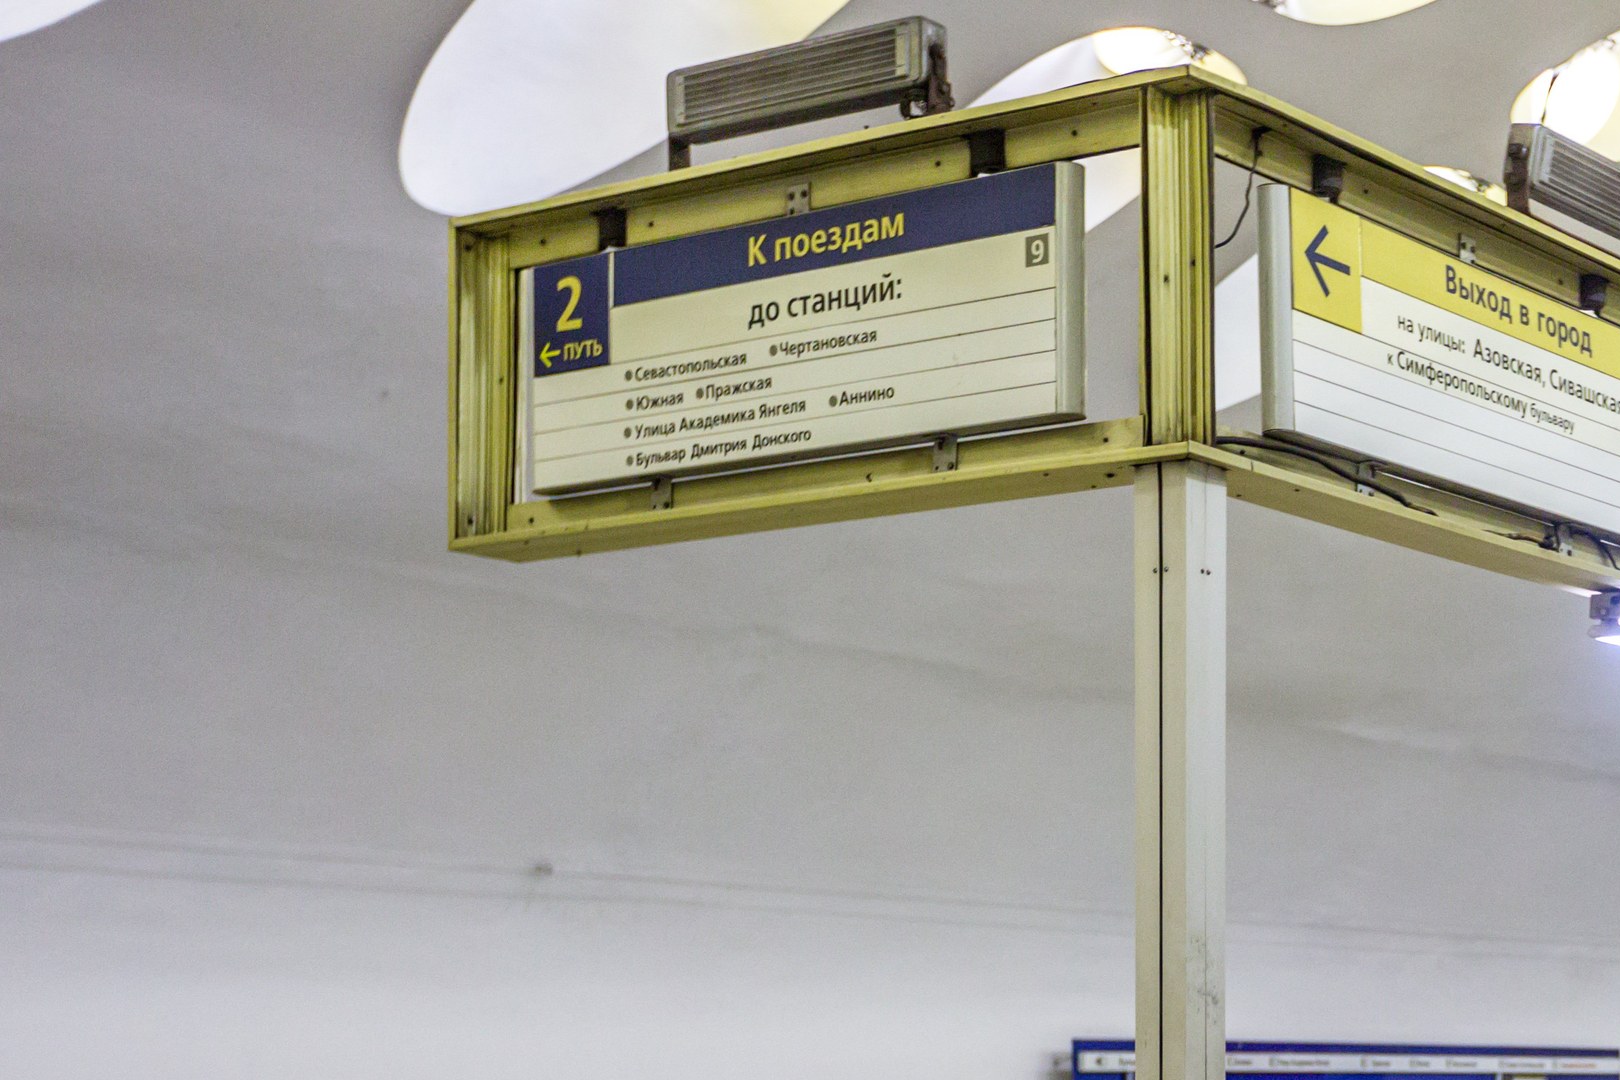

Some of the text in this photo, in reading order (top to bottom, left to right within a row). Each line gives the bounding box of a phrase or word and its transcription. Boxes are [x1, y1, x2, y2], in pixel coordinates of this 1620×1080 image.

[747, 211, 905, 267] К поездам
[1030, 239, 1047, 263] 9
[555, 275, 584, 334] 2
[747, 273, 903, 330] до станций:
[1445, 264, 1593, 358] Выход в город
[634, 327, 878, 381] Севастопольская Чертановская
[1397, 313, 1415, 334] на
[1417, 319, 1466, 354] улицы:
[1473, 338, 1547, 388] Азовская,
[635, 385, 896, 440] Улица Академика Янгеля Аннино
[636, 376, 772, 411] Южная Пражская
[1386, 351, 1575, 436] к Симферопольскому бульвару
[636, 426, 812, 469] Бульвар Дмитрия Донского
